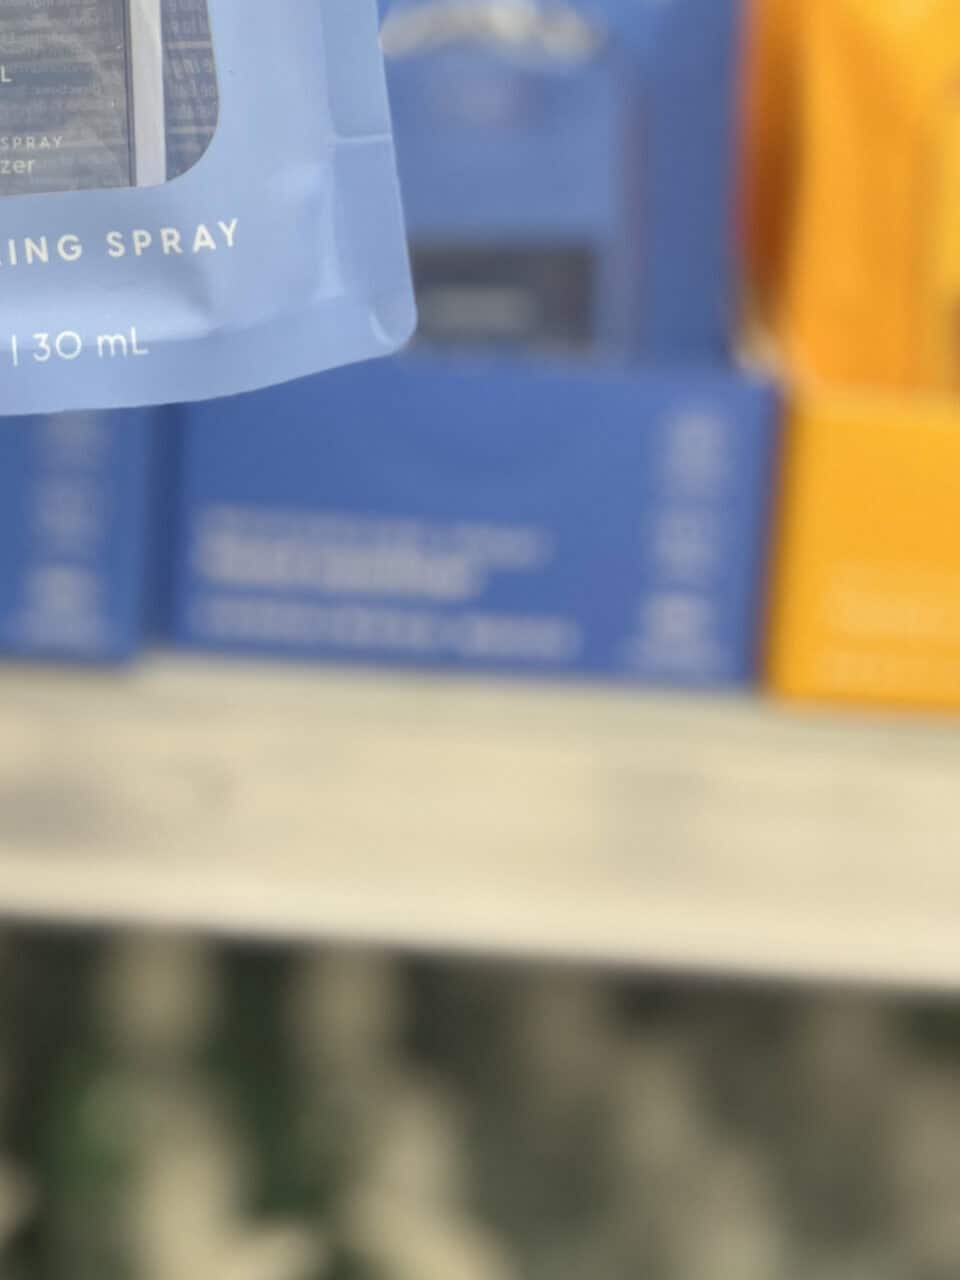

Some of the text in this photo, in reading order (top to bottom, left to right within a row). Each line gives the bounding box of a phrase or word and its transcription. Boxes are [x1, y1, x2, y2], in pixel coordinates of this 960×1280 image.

[0, 135, 65, 150] SPRAY
[106, 218, 240, 258] SPRAY
[33, 330, 82, 363] 30
[98, 326, 150, 358] mL
